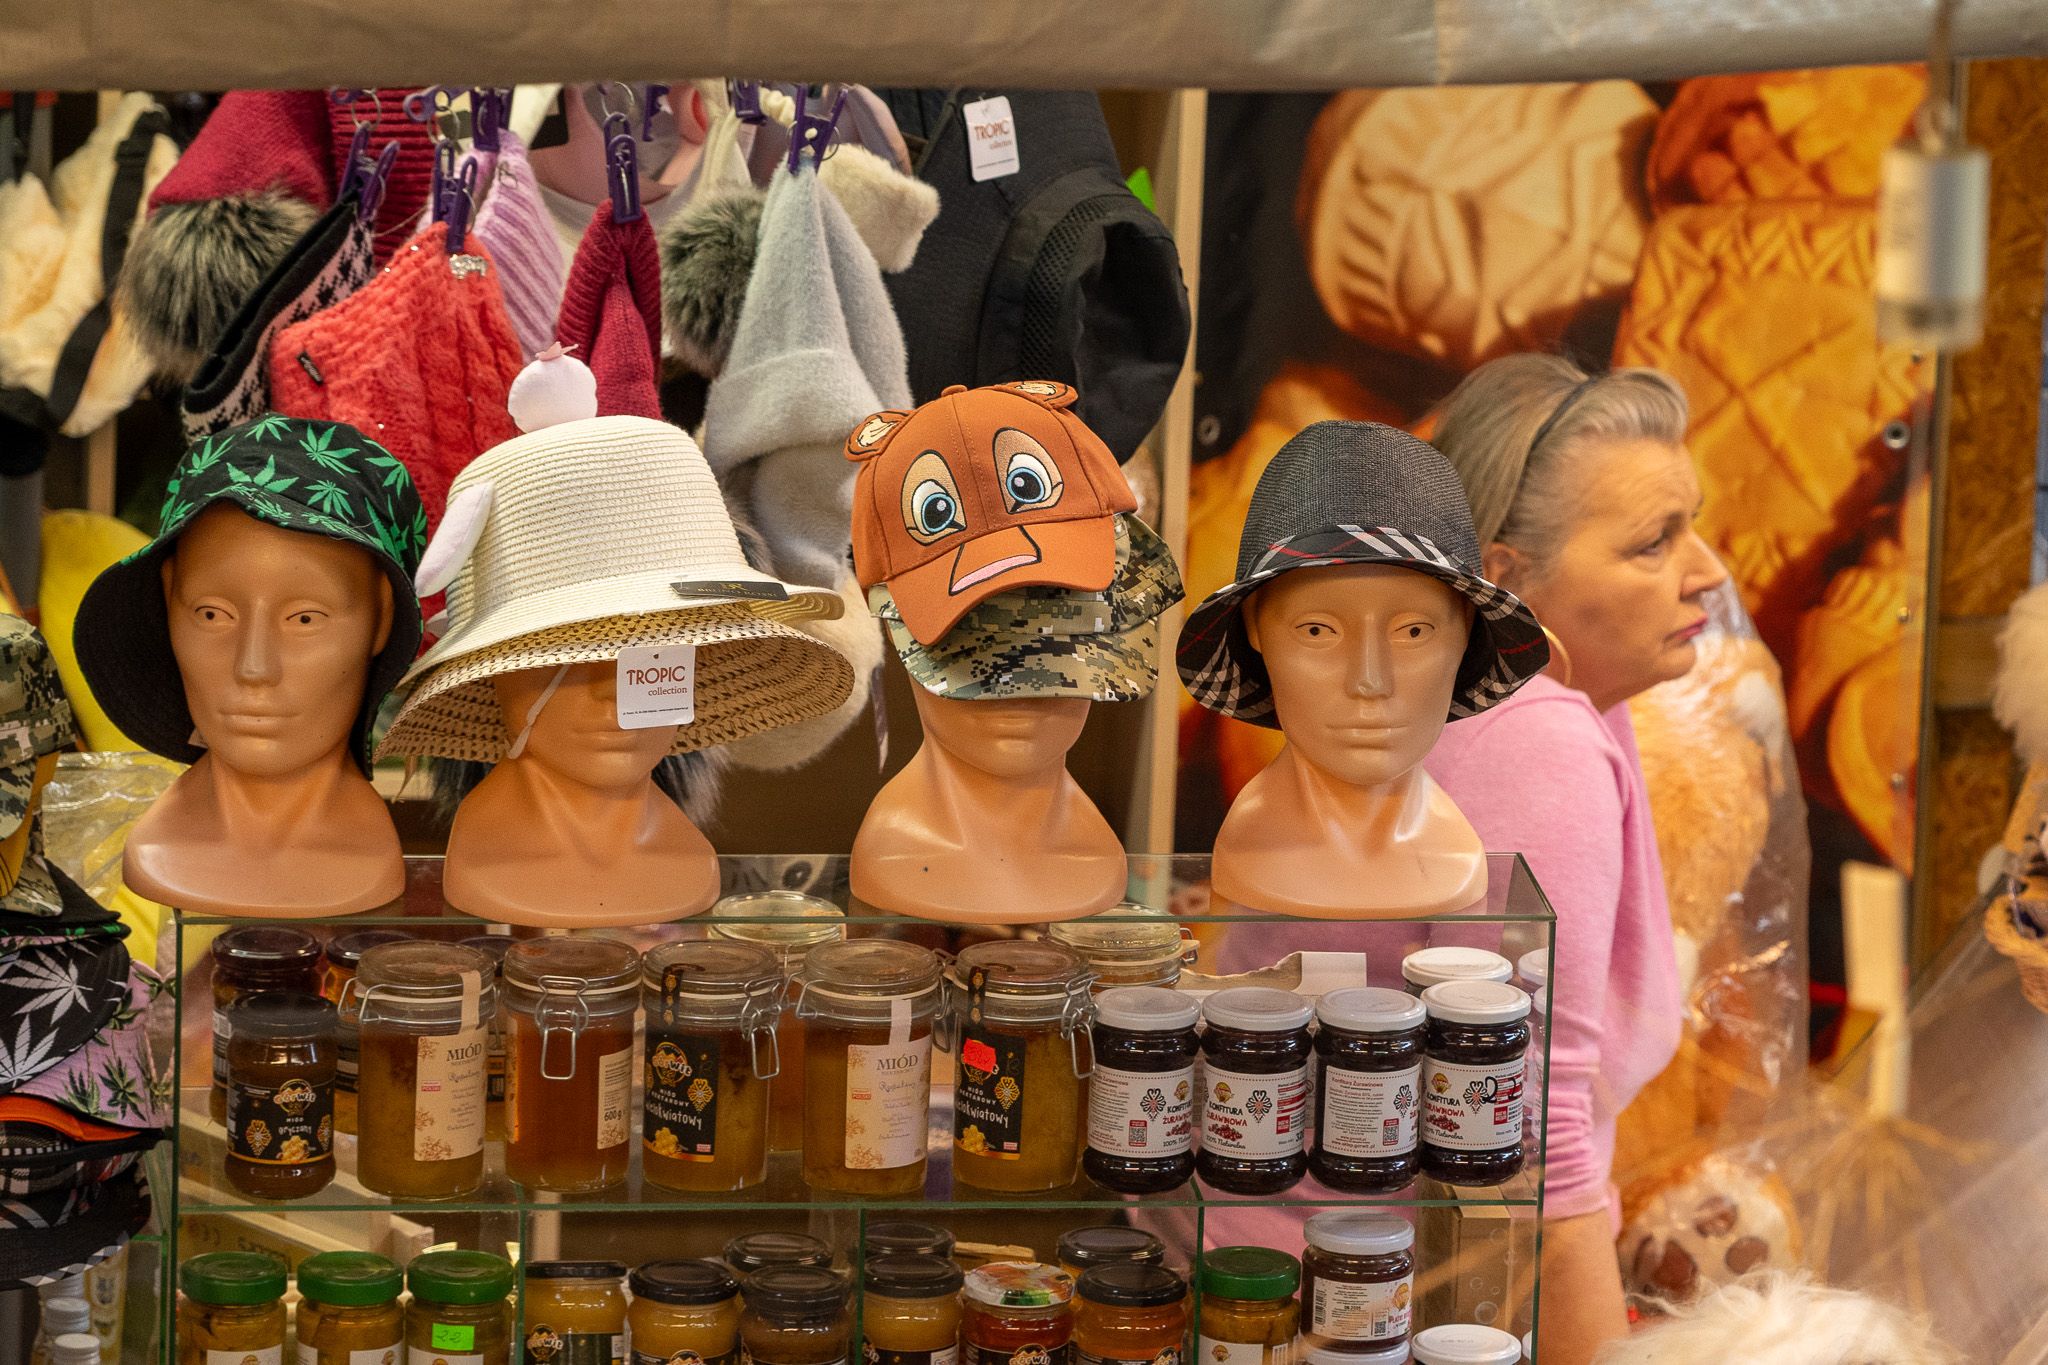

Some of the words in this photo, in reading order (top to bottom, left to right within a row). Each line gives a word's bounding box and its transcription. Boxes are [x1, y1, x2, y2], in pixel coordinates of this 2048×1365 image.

[974, 120, 1009, 140] TROPIC
[626, 665, 686, 686] TROPIC
[648, 686, 688, 696] collection
[446, 1043, 482, 1061] MIÓD
[876, 1053, 918, 1070] MIÓD
[604, 1111, 617, 1121] 600
[1209, 1101, 1243, 1115] KONFITURA
